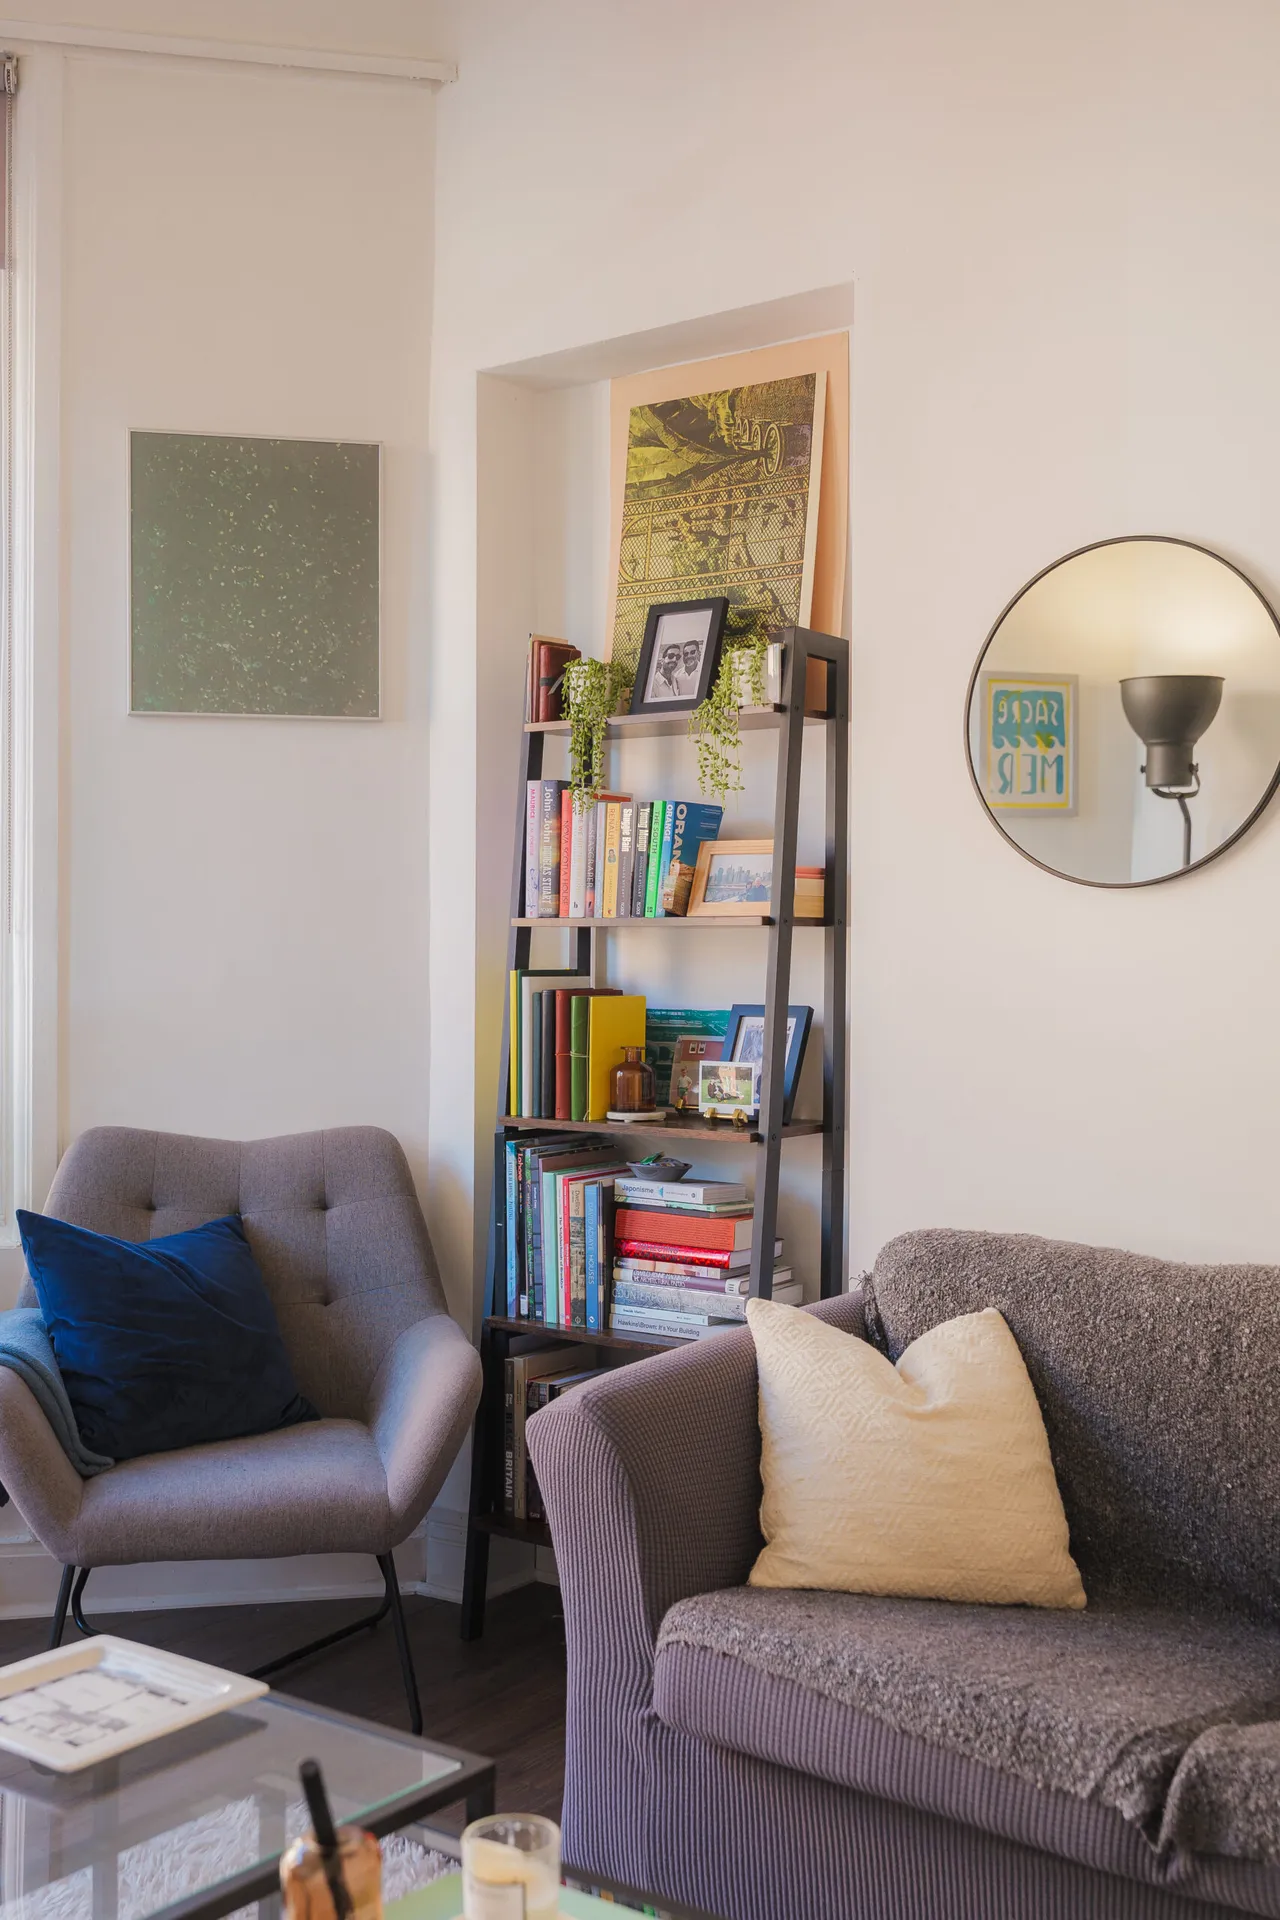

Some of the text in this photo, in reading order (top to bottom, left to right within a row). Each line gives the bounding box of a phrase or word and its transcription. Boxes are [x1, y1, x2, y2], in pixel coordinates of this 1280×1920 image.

[543, 786, 554, 812] John
[543, 818, 553, 843] John
[607, 808, 616, 847] RENAULT
[621, 808, 633, 852] Shuggie Bain
[637, 807, 650, 852] Young Mungo
[663, 804, 674, 842] ORANGE
[651, 827, 660, 854] SOUTH
[586, 828, 595, 889] SEASCRAPER
[541, 877, 552, 905] STUART
[573, 1190, 581, 1216] Dwellings
[621, 1184, 654, 1194] Japonisme
[678, 1328, 700, 1336] Building
[505, 1451, 513, 1498] BRITAIN
